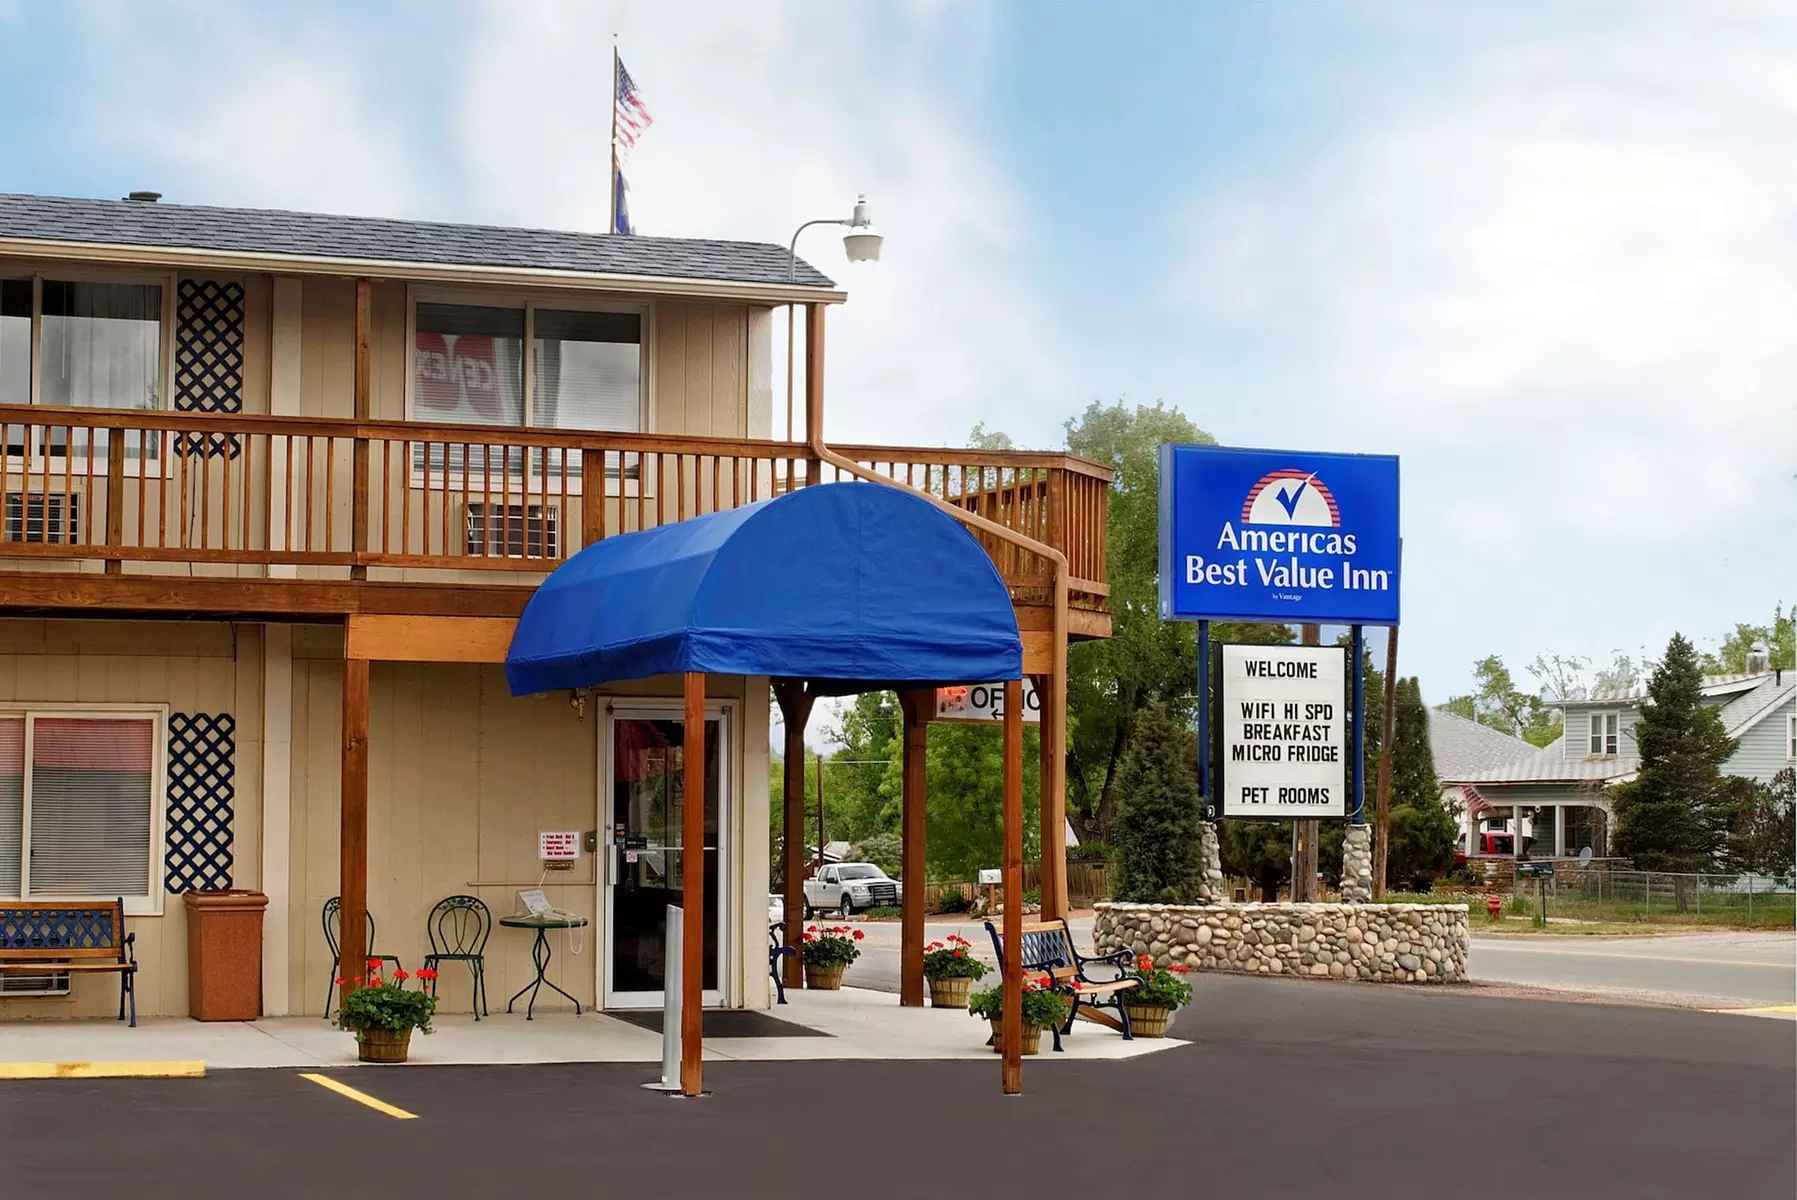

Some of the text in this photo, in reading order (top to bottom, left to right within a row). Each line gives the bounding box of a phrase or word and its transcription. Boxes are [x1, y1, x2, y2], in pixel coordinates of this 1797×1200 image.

[1216, 521, 1357, 555] Americas
[1186, 555, 1389, 591] Best Value Inn
[1278, 592, 1303, 602] Vantage
[1244, 660, 1318, 679] WELCOME
[1240, 702, 1333, 720] WIFI HI SPD
[1243, 723, 1331, 741] BREAKFAST
[1232, 744, 1338, 762] MICRO FRIDGE
[1241, 786, 1330, 804] PET ROOMS
